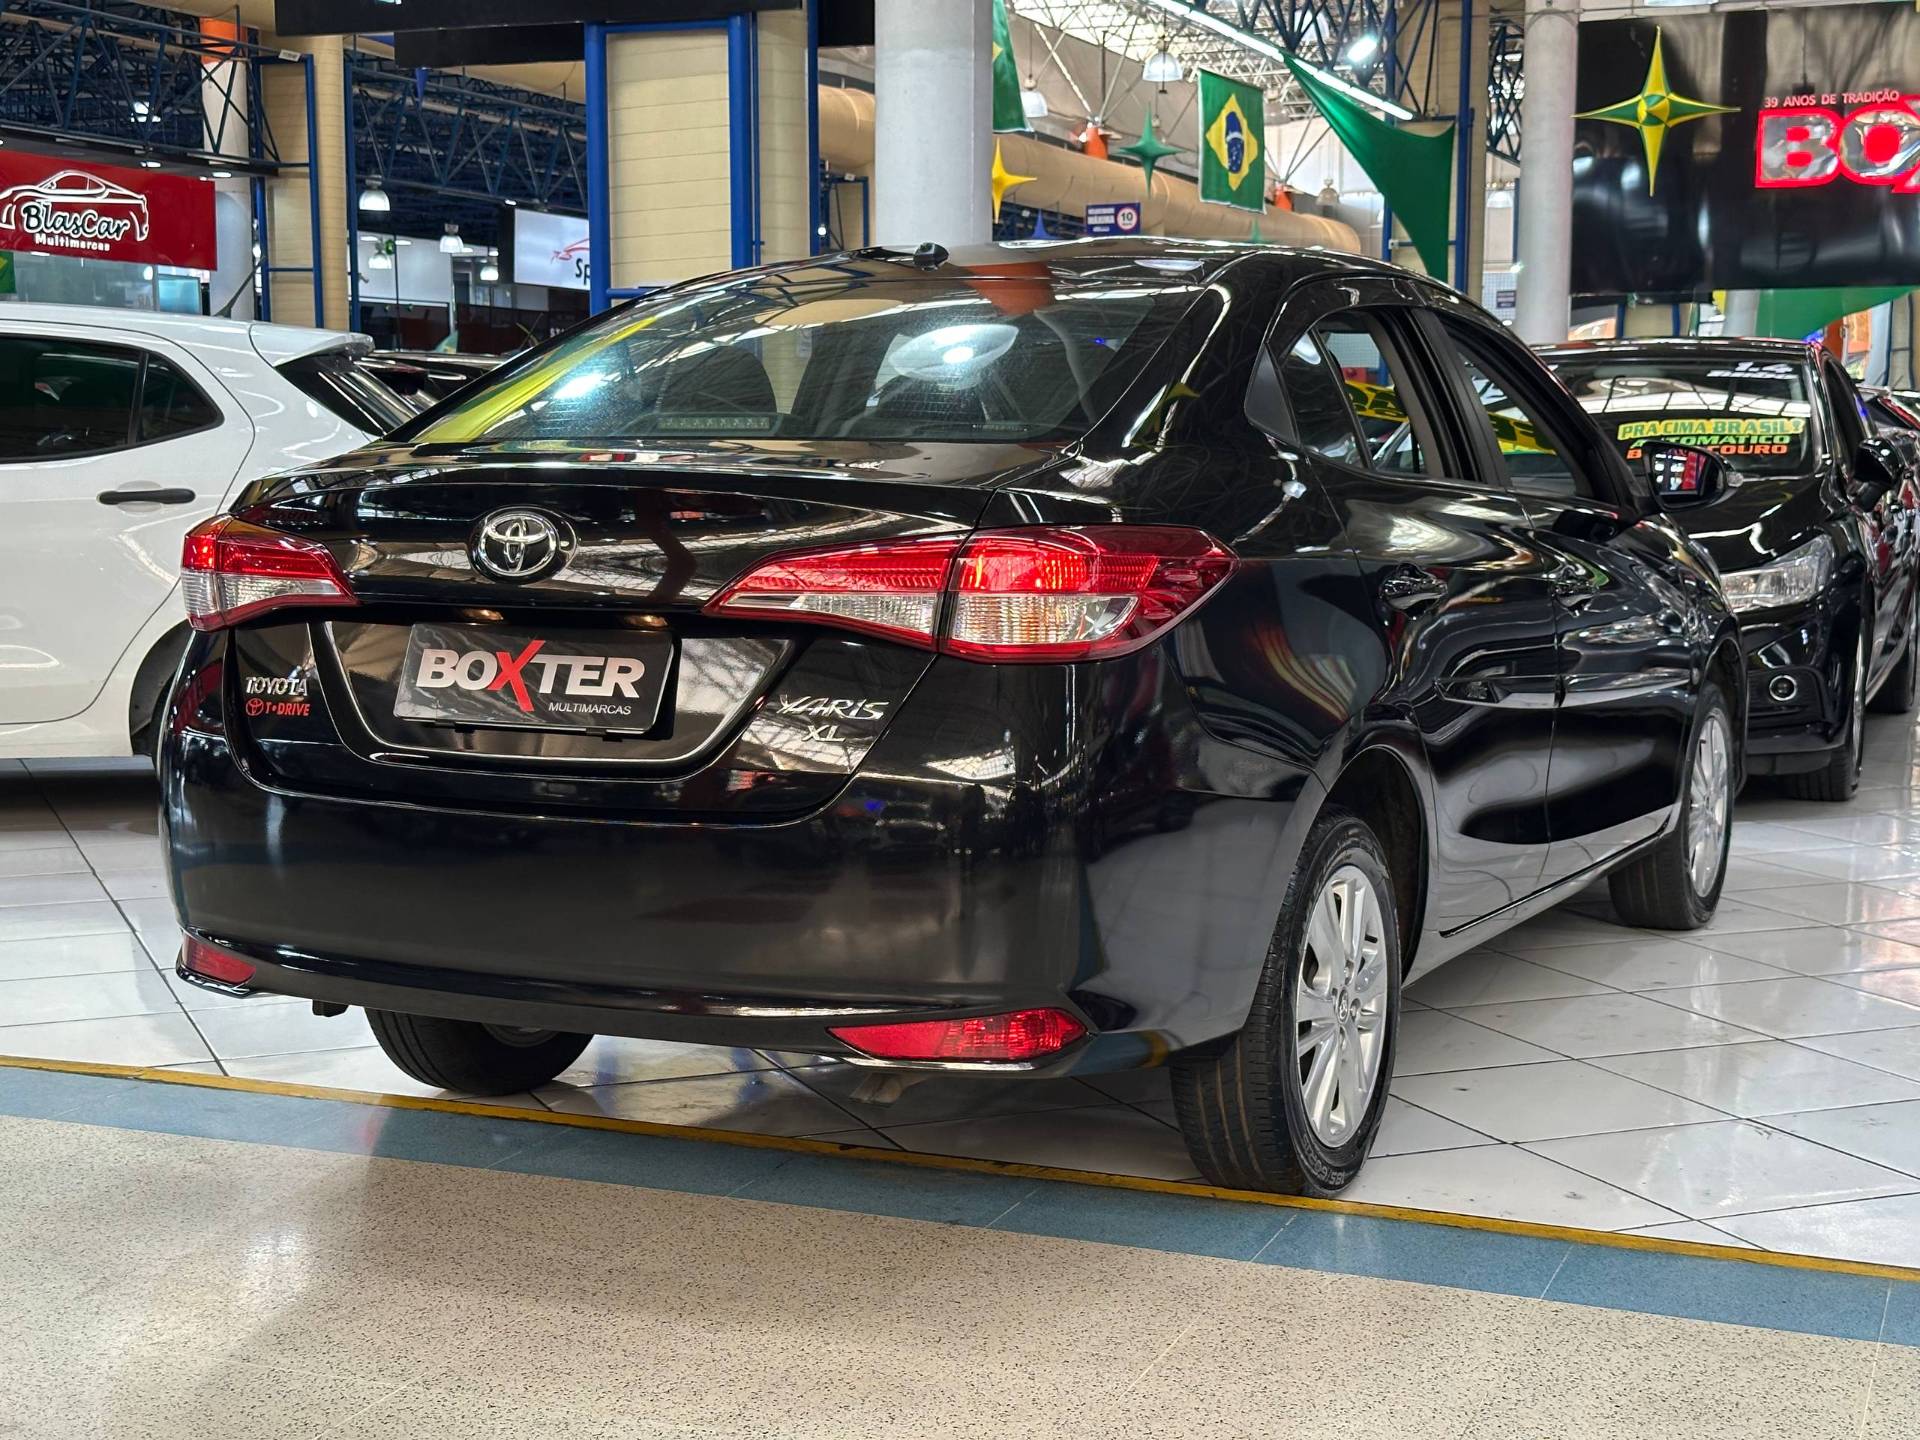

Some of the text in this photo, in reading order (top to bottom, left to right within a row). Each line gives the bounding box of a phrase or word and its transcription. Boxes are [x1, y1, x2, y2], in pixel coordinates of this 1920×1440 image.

[1764, 88, 1900, 108] 39 ANOS DE TRADIÇÃO
[1755, 94, 1920, 193] BO
[22, 201, 130, 241] BlasCar
[1121, 211, 1134, 222] 10
[35, 233, 110, 251] Multimarcas
[1661, 420, 1707, 435] CIMA
[416, 640, 645, 712] BOXTER
[246, 676, 308, 697] TOYOTA
[548, 701, 632, 715] MULTIMARCAS
[776, 694, 889, 720] YARIS
[801, 724, 846, 742] XL
